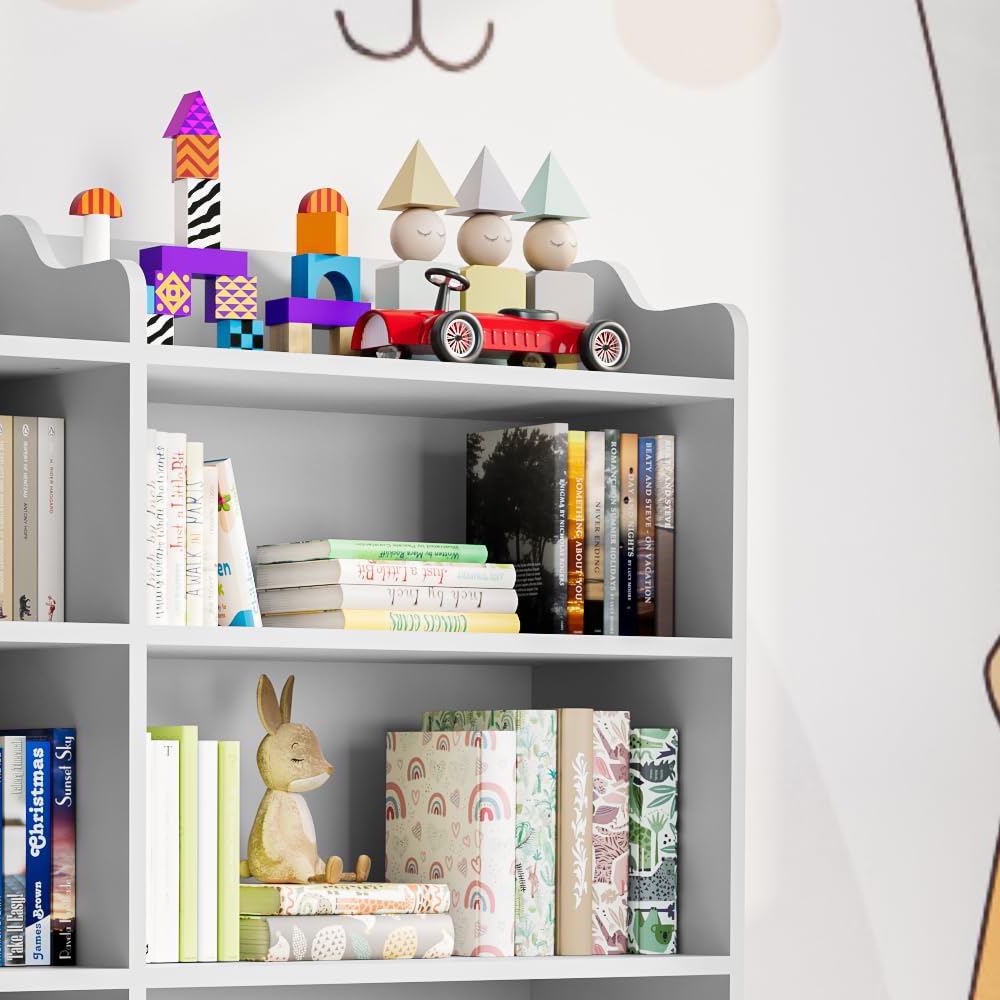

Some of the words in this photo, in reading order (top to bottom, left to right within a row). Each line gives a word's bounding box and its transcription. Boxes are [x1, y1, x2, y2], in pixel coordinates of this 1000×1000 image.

[169, 451, 185, 471] Bit
[644, 442, 653, 473] BEATY
[169, 472, 185, 508] Little
[558, 479, 566, 508] ENIGMA
[627, 473, 635, 494] DAY
[644, 474, 653, 496] AND
[663, 478, 673, 496] AND
[558, 509, 566, 518] BY
[575, 477, 584, 538] SOMETHING
[593, 501, 601, 533] NEVER
[644, 498, 653, 529] STEVE
[663, 498, 673, 529] STEVE
[169, 524, 185, 553] Just
[558, 519, 566, 557] NICHOLAS
[609, 506, 617, 545] SUMMER
[627, 521, 635, 557] NIGHTS
[426, 549, 433, 559] by
[434, 550, 460, 561] Written
[593, 535, 601, 574] ENDING
[644, 536, 653, 551] ON
[356, 563, 375, 580] Bit
[575, 540, 584, 576] ABOUT
[609, 546, 617, 591] HOLIDAYS
[376, 565, 408, 583] Little
[410, 567, 419, 577] a
[422, 568, 448, 585] Just
[558, 558, 566, 586] ROGERS
[627, 567, 635, 581] LUCY
[644, 553, 653, 604] VACATION
[386, 588, 420, 606] Inch
[428, 586, 445, 607] by
[450, 591, 483, 609] Inch
[575, 578, 584, 602] YOU
[627, 581, 635, 601] MOORE
[54, 736, 75, 762] Sky
[54, 765, 75, 808] Sunset
[28, 747, 47, 859] Christmas
[6, 893, 26, 922] Easy!
[31, 880, 45, 921] Brown
[6, 924, 26, 933] It
[6, 934, 26, 961] Take
[58, 926, 72, 960] Ravela
